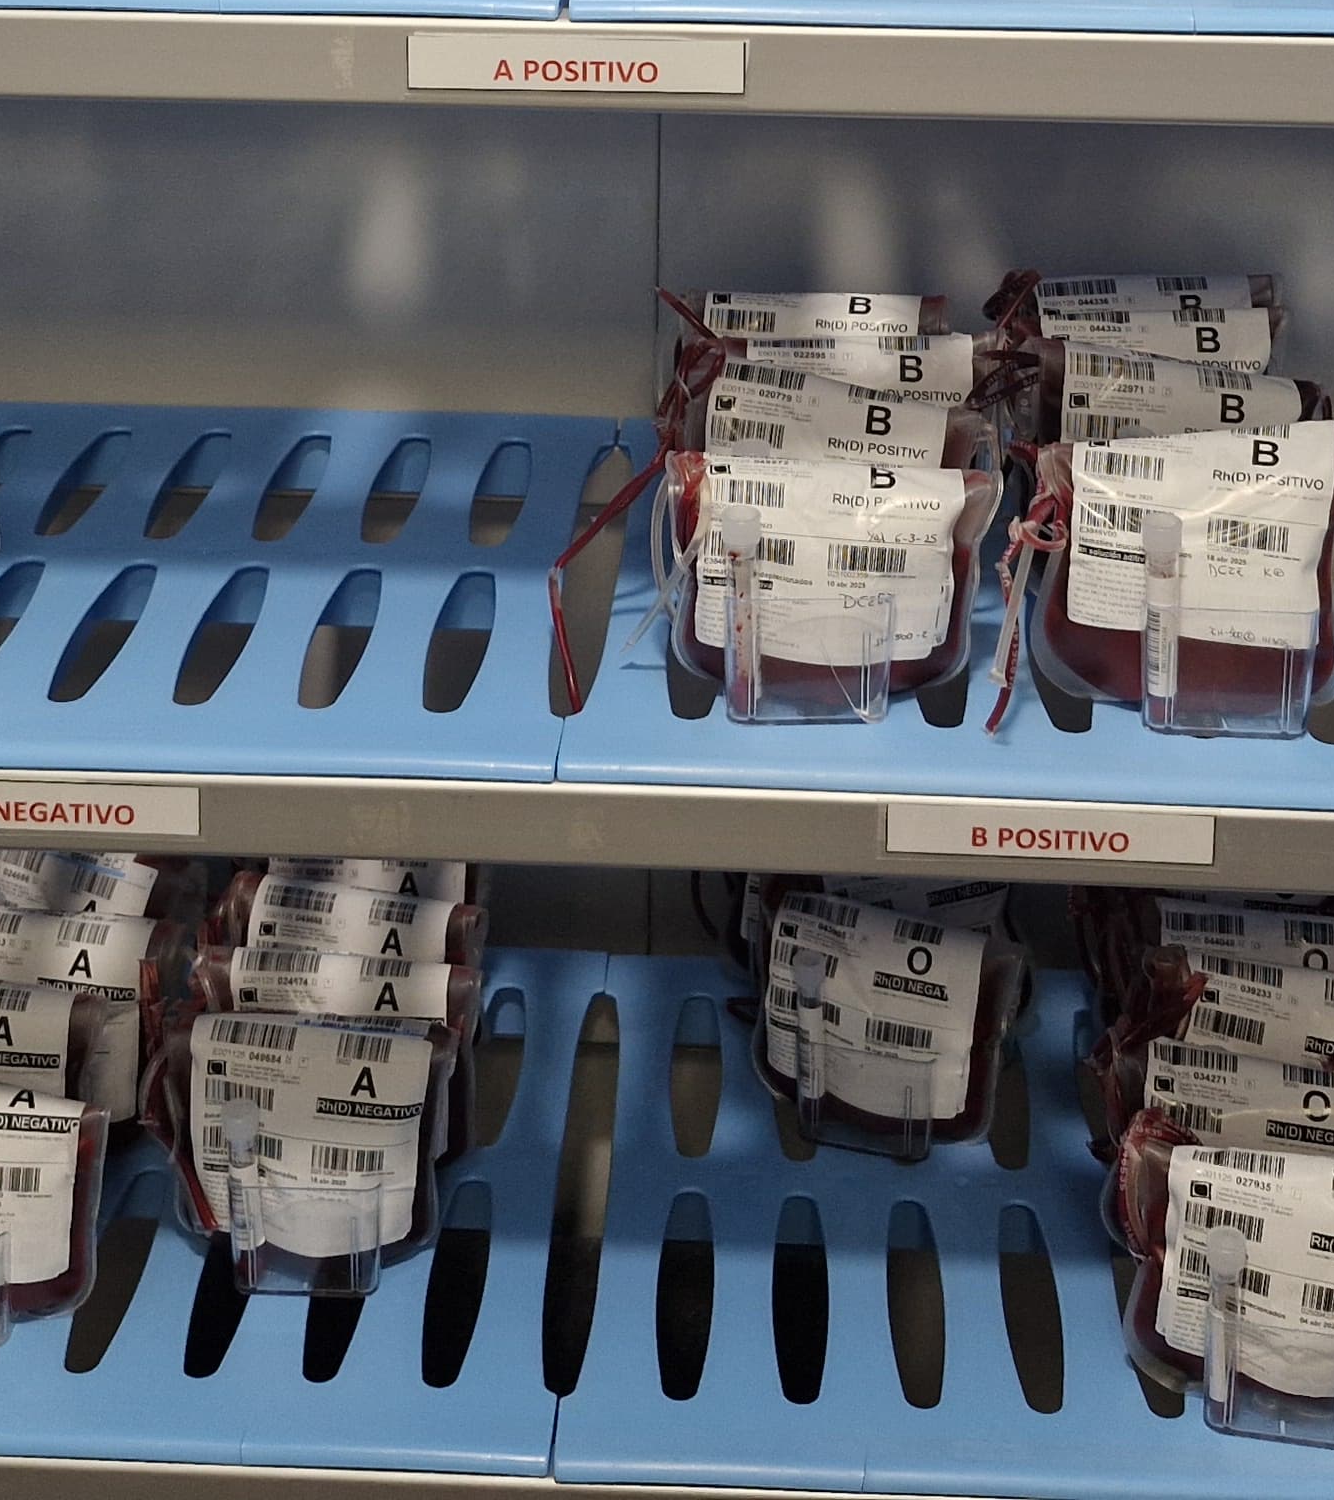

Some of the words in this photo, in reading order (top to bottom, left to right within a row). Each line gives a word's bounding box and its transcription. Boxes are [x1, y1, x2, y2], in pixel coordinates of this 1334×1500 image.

[493, 59, 513, 81] A
[525, 60, 658, 84] POSITIVO
[849, 297, 872, 315] B
[815, 318, 847, 332] Rh(D)
[1195, 327, 1221, 353] B
[899, 355, 923, 382] B
[865, 405, 892, 436] B
[1220, 394, 1245, 424] B
[827, 437, 864, 453] Rh(D)
[1251, 440, 1280, 467] B
[870, 468, 896, 489] B
[1212, 469, 1251, 484] Rh(D)
[832, 493, 869, 508] Rh(D)
[971, 827, 987, 847] B
[998, 828, 1129, 852] POSITIVO
[398, 872, 419, 897] A
[380, 928, 403, 957] A
[68, 949, 92, 979] A
[906, 946, 933, 976] O
[874, 973, 905, 991] Rh(D)
[374, 982, 399, 1012] A
[350, 1067, 377, 1098] A
[9, 1089, 35, 1109] A
[318, 1101, 352, 1116] Rh(D)
[355, 1103, 423, 1119] NEGATIVO
[1303, 1090, 1331, 1123] O
[12, 1116, 80, 1132] NEGATIVO
[1267, 1122, 1303, 1141] Rh(D)
[1235, 1176, 1272, 1192] 027935
